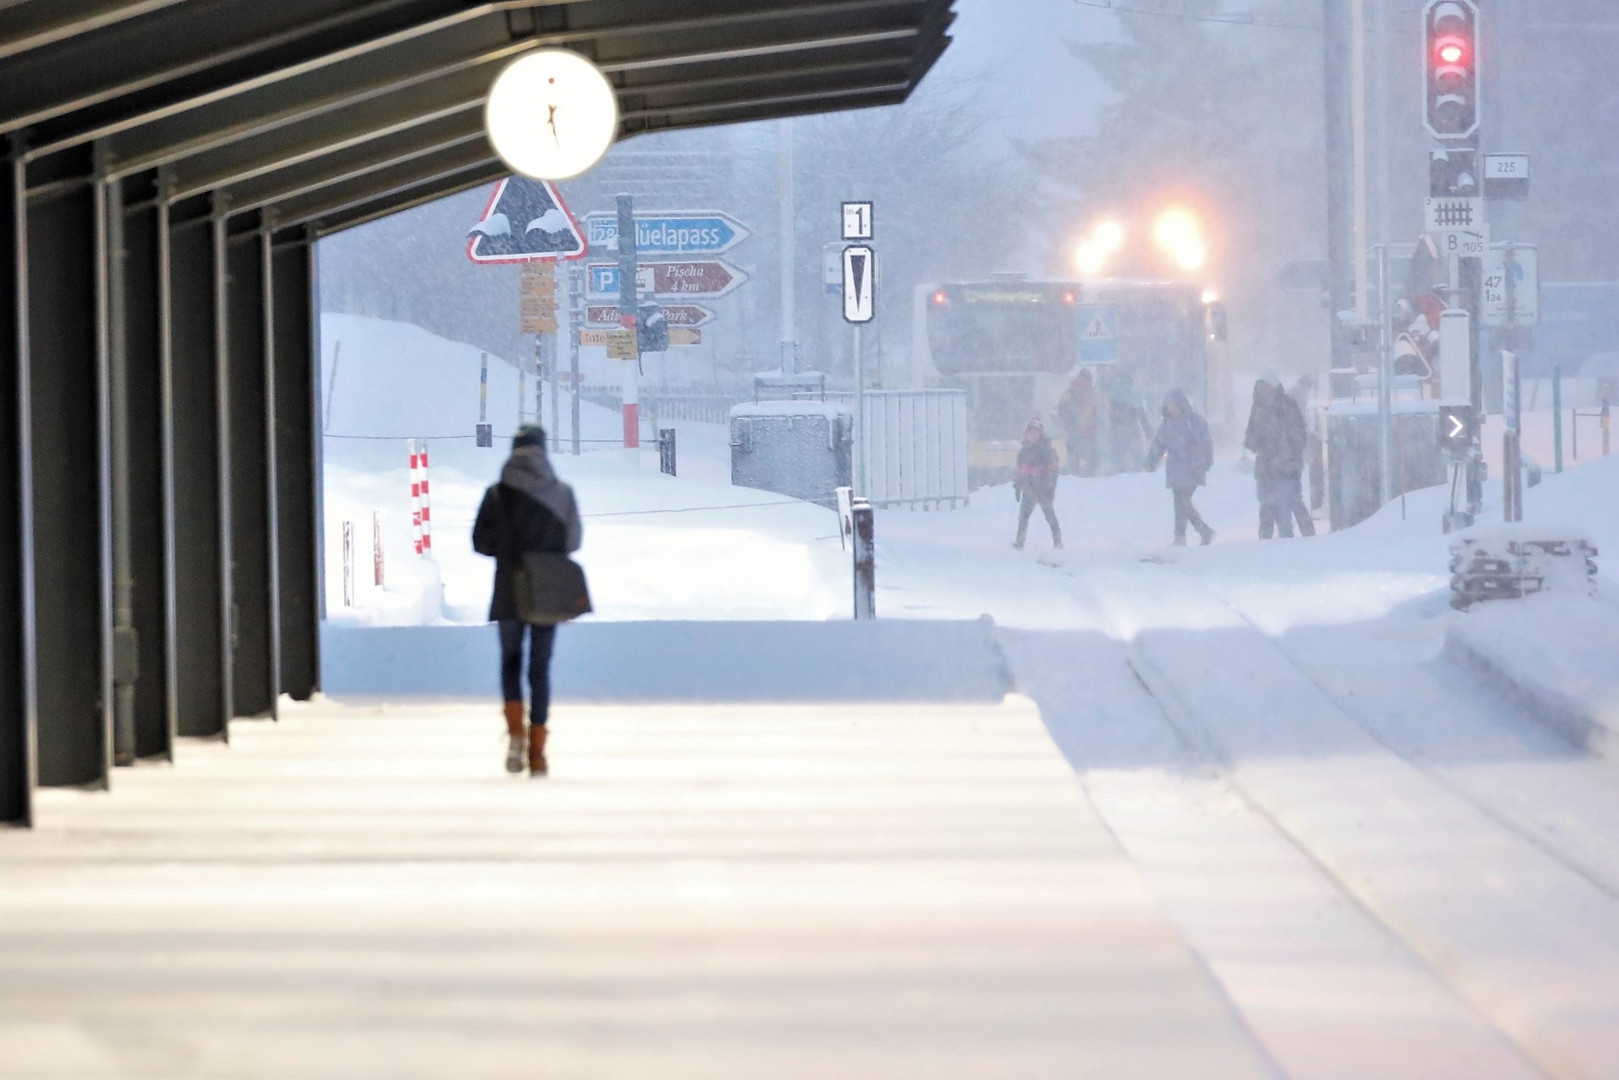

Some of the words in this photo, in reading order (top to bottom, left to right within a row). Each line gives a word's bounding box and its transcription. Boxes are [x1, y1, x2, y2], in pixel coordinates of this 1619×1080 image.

[1497, 162, 1516, 173] 225
[855, 206, 863, 235] 1
[635, 222, 719, 251] lüelapass
[1447, 234, 1458, 251] B
[666, 264, 705, 278] Pischa
[600, 271, 614, 291] P
[670, 280, 679, 292] 4
[681, 280, 701, 292] km
[1485, 275, 1503, 288] 47
